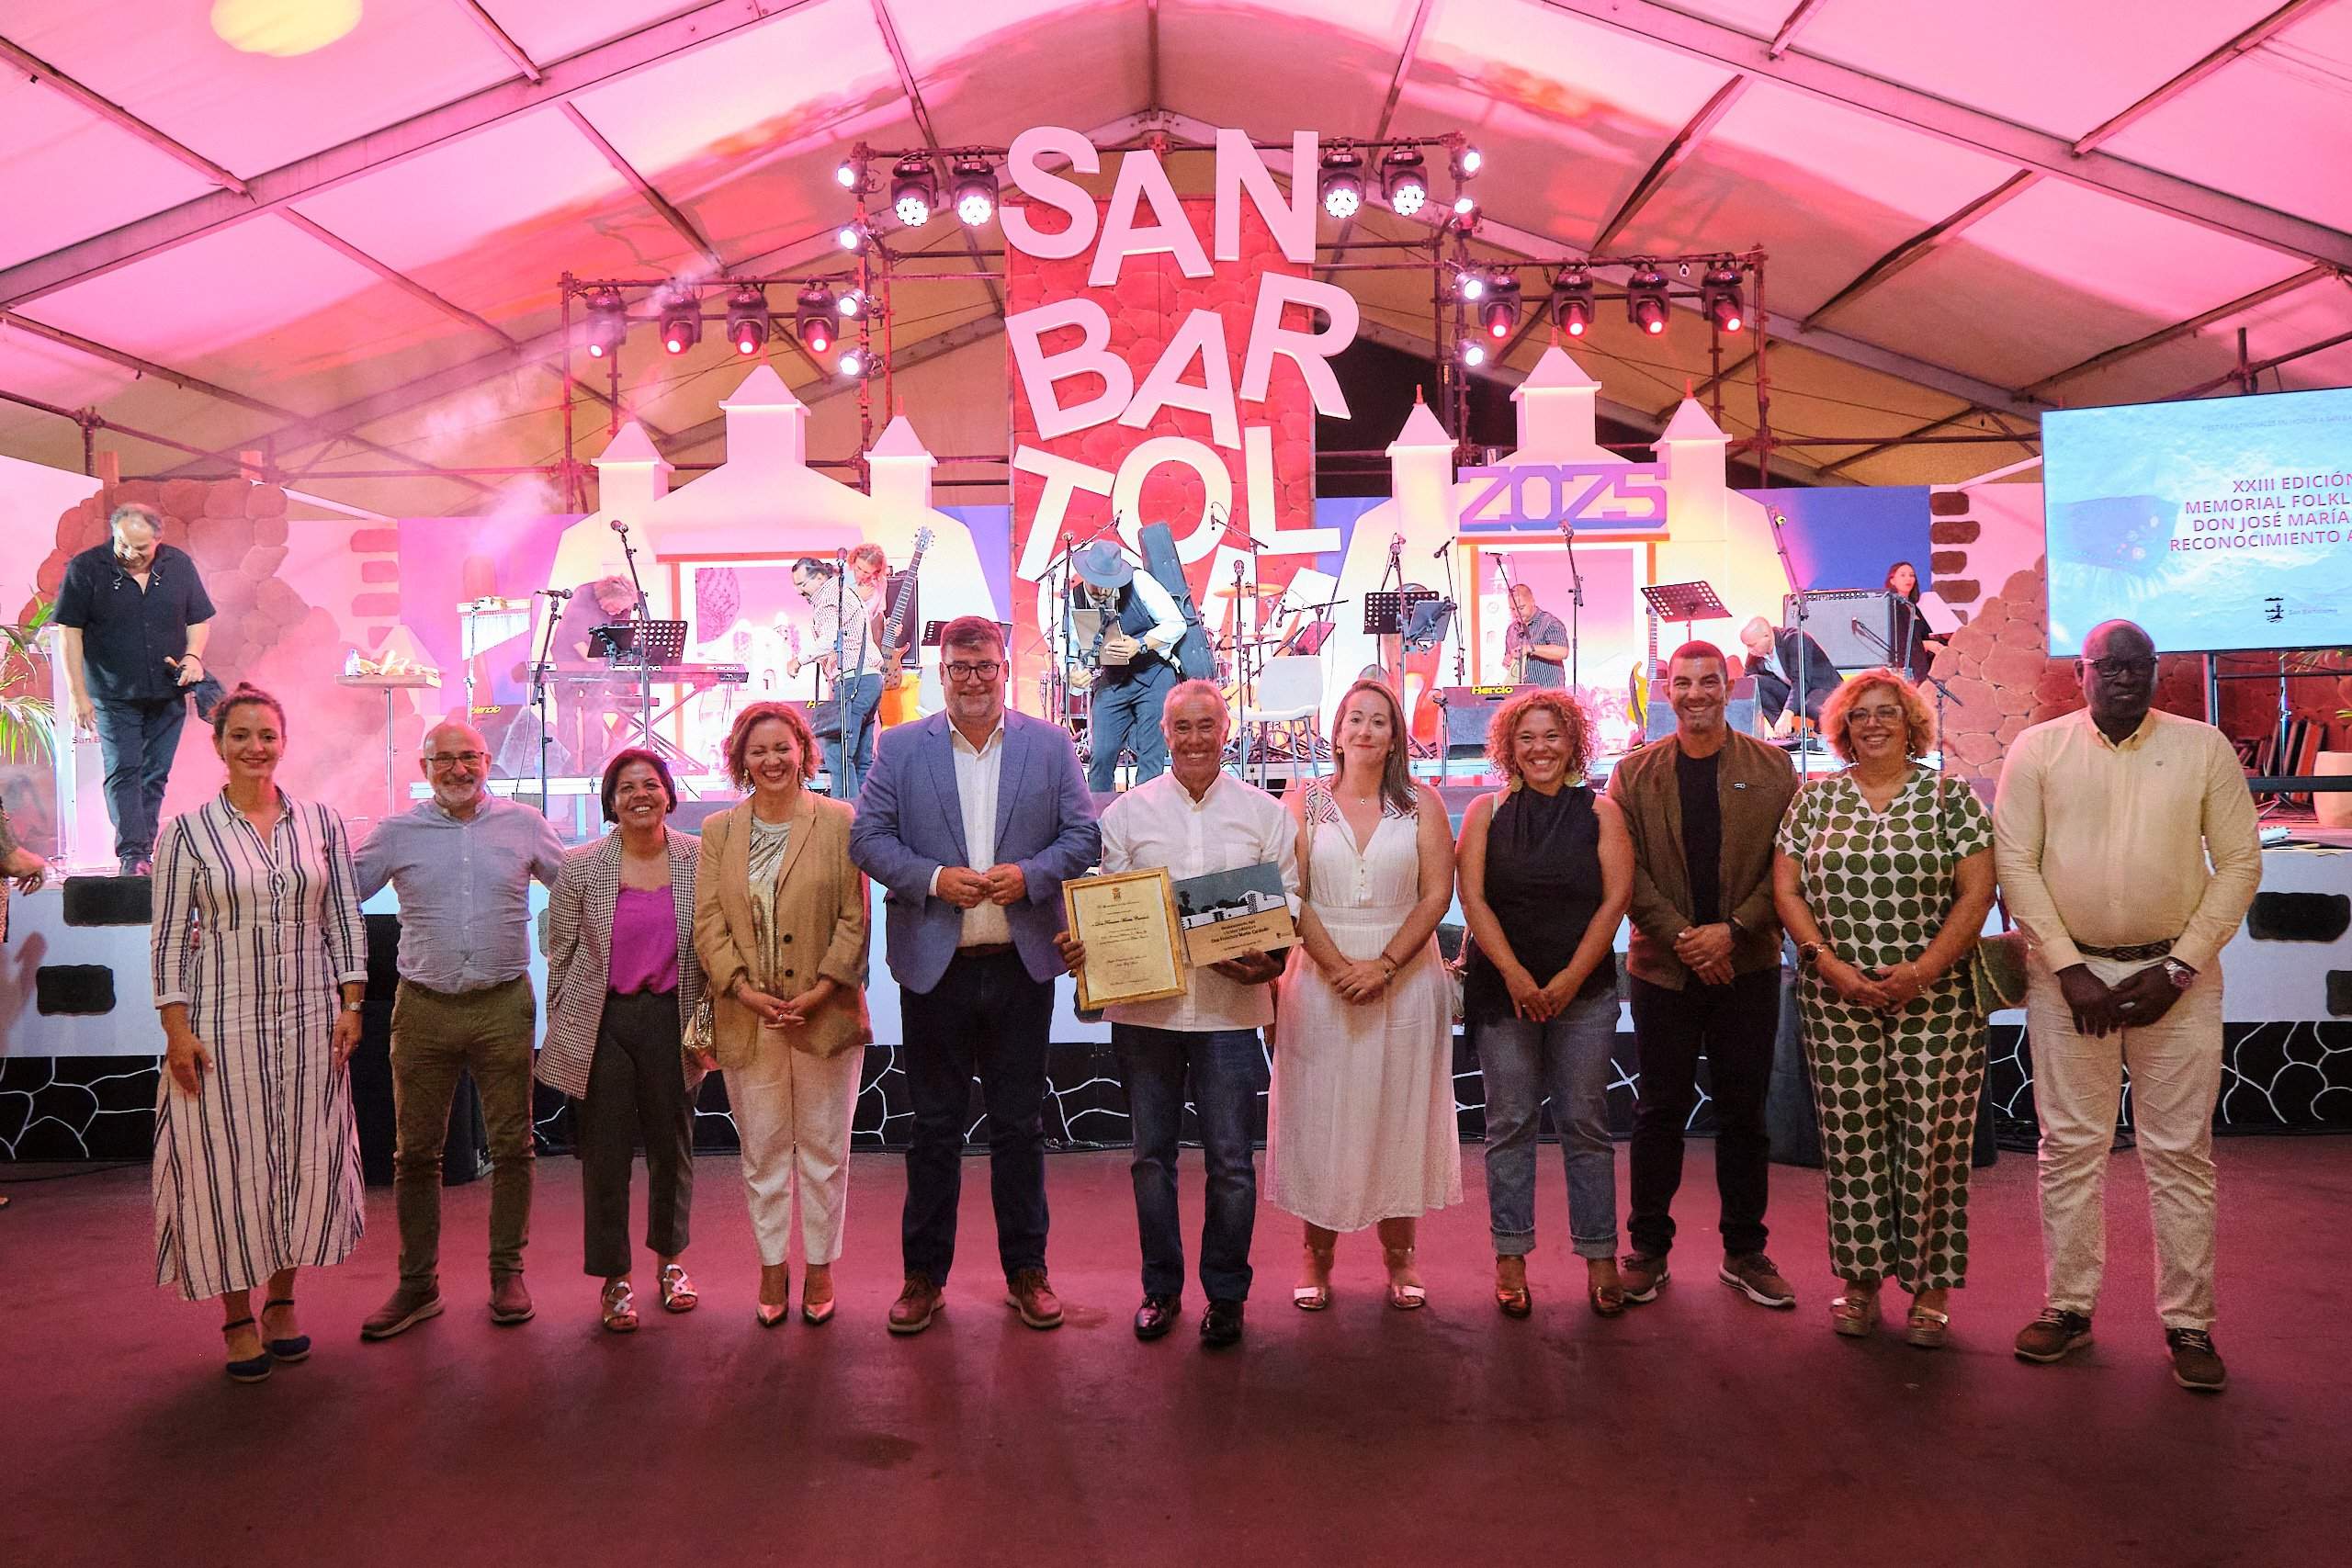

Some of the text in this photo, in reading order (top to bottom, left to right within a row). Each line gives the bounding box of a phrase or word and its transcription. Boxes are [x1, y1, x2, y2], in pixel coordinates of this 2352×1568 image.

[999, 125, 1320, 288] SAN
[1004, 271, 1361, 451] BAR
[1456, 462, 1668, 533] 2025
[2233, 478, 2276, 493] XXIII
[1012, 425, 1342, 584] TOL
[2185, 492, 2352, 514] MEMORIAL FOLKL
[2193, 508, 2350, 533] DON JOSÉ MARÍA
[2170, 529, 2341, 551] RECONOCIMIENTO
[73, 736, 92, 744] San
